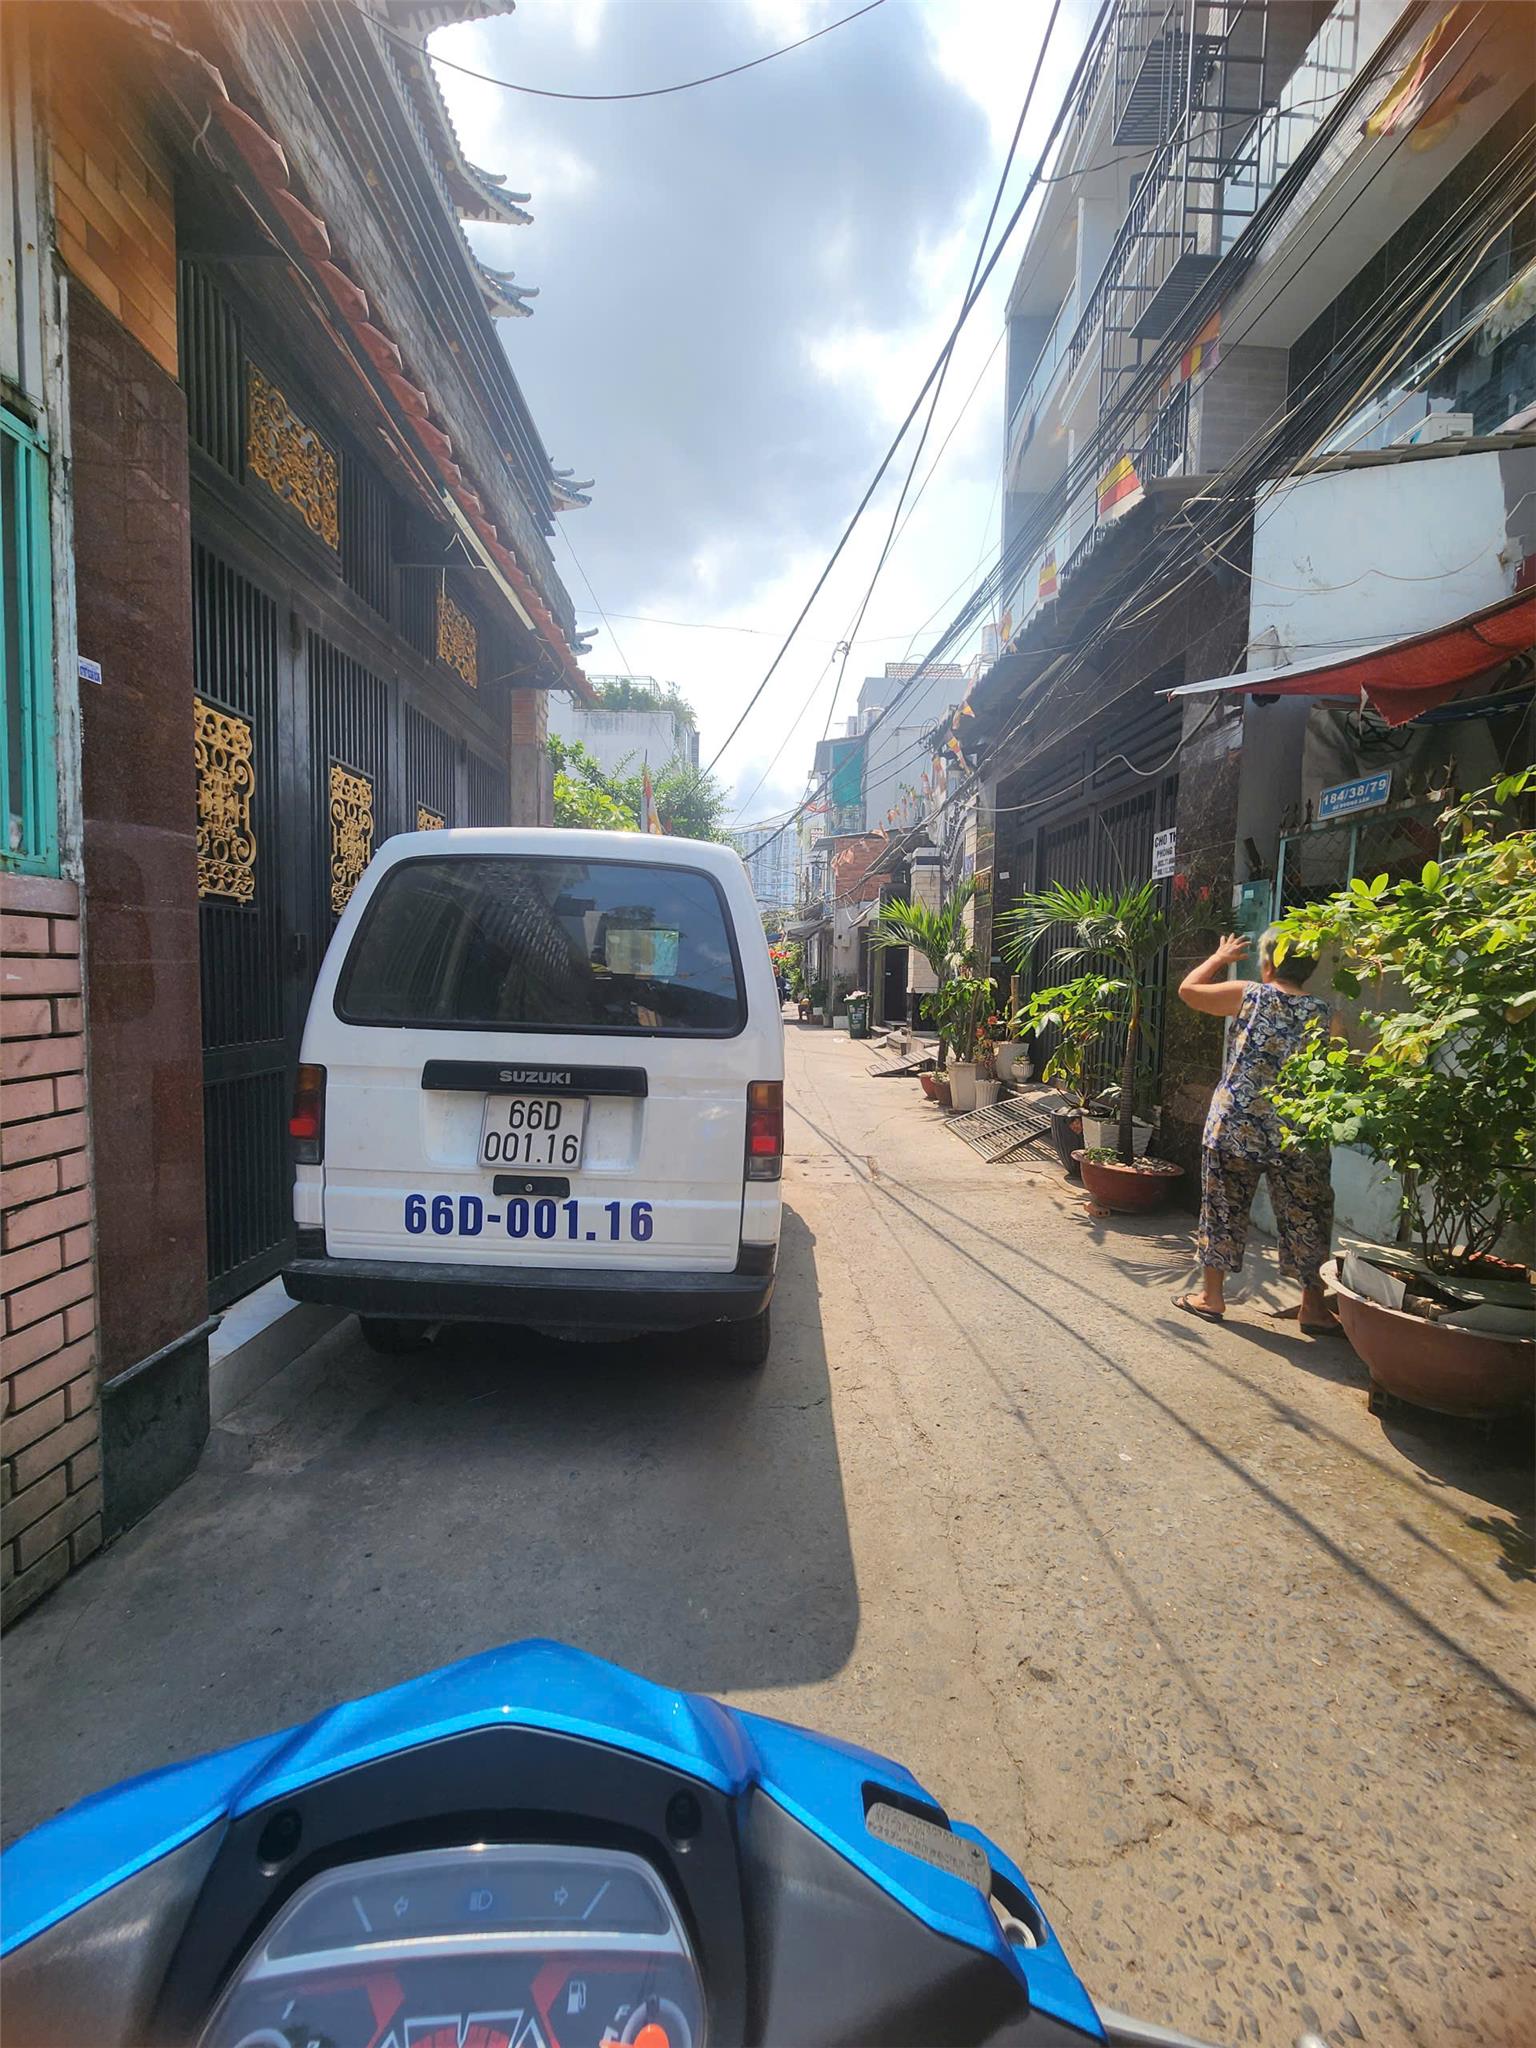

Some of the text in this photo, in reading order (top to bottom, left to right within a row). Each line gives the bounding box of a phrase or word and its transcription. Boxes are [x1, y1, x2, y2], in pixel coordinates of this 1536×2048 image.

[1323, 779, 1386, 805] 184/38/79
[1155, 834, 1167, 847] CHO
[499, 1070, 571, 1085] SUZUKI
[509, 1099, 562, 1131] 66D
[483, 1132, 579, 1164] 001.16
[404, 1194, 654, 1242] 66D-001.16
